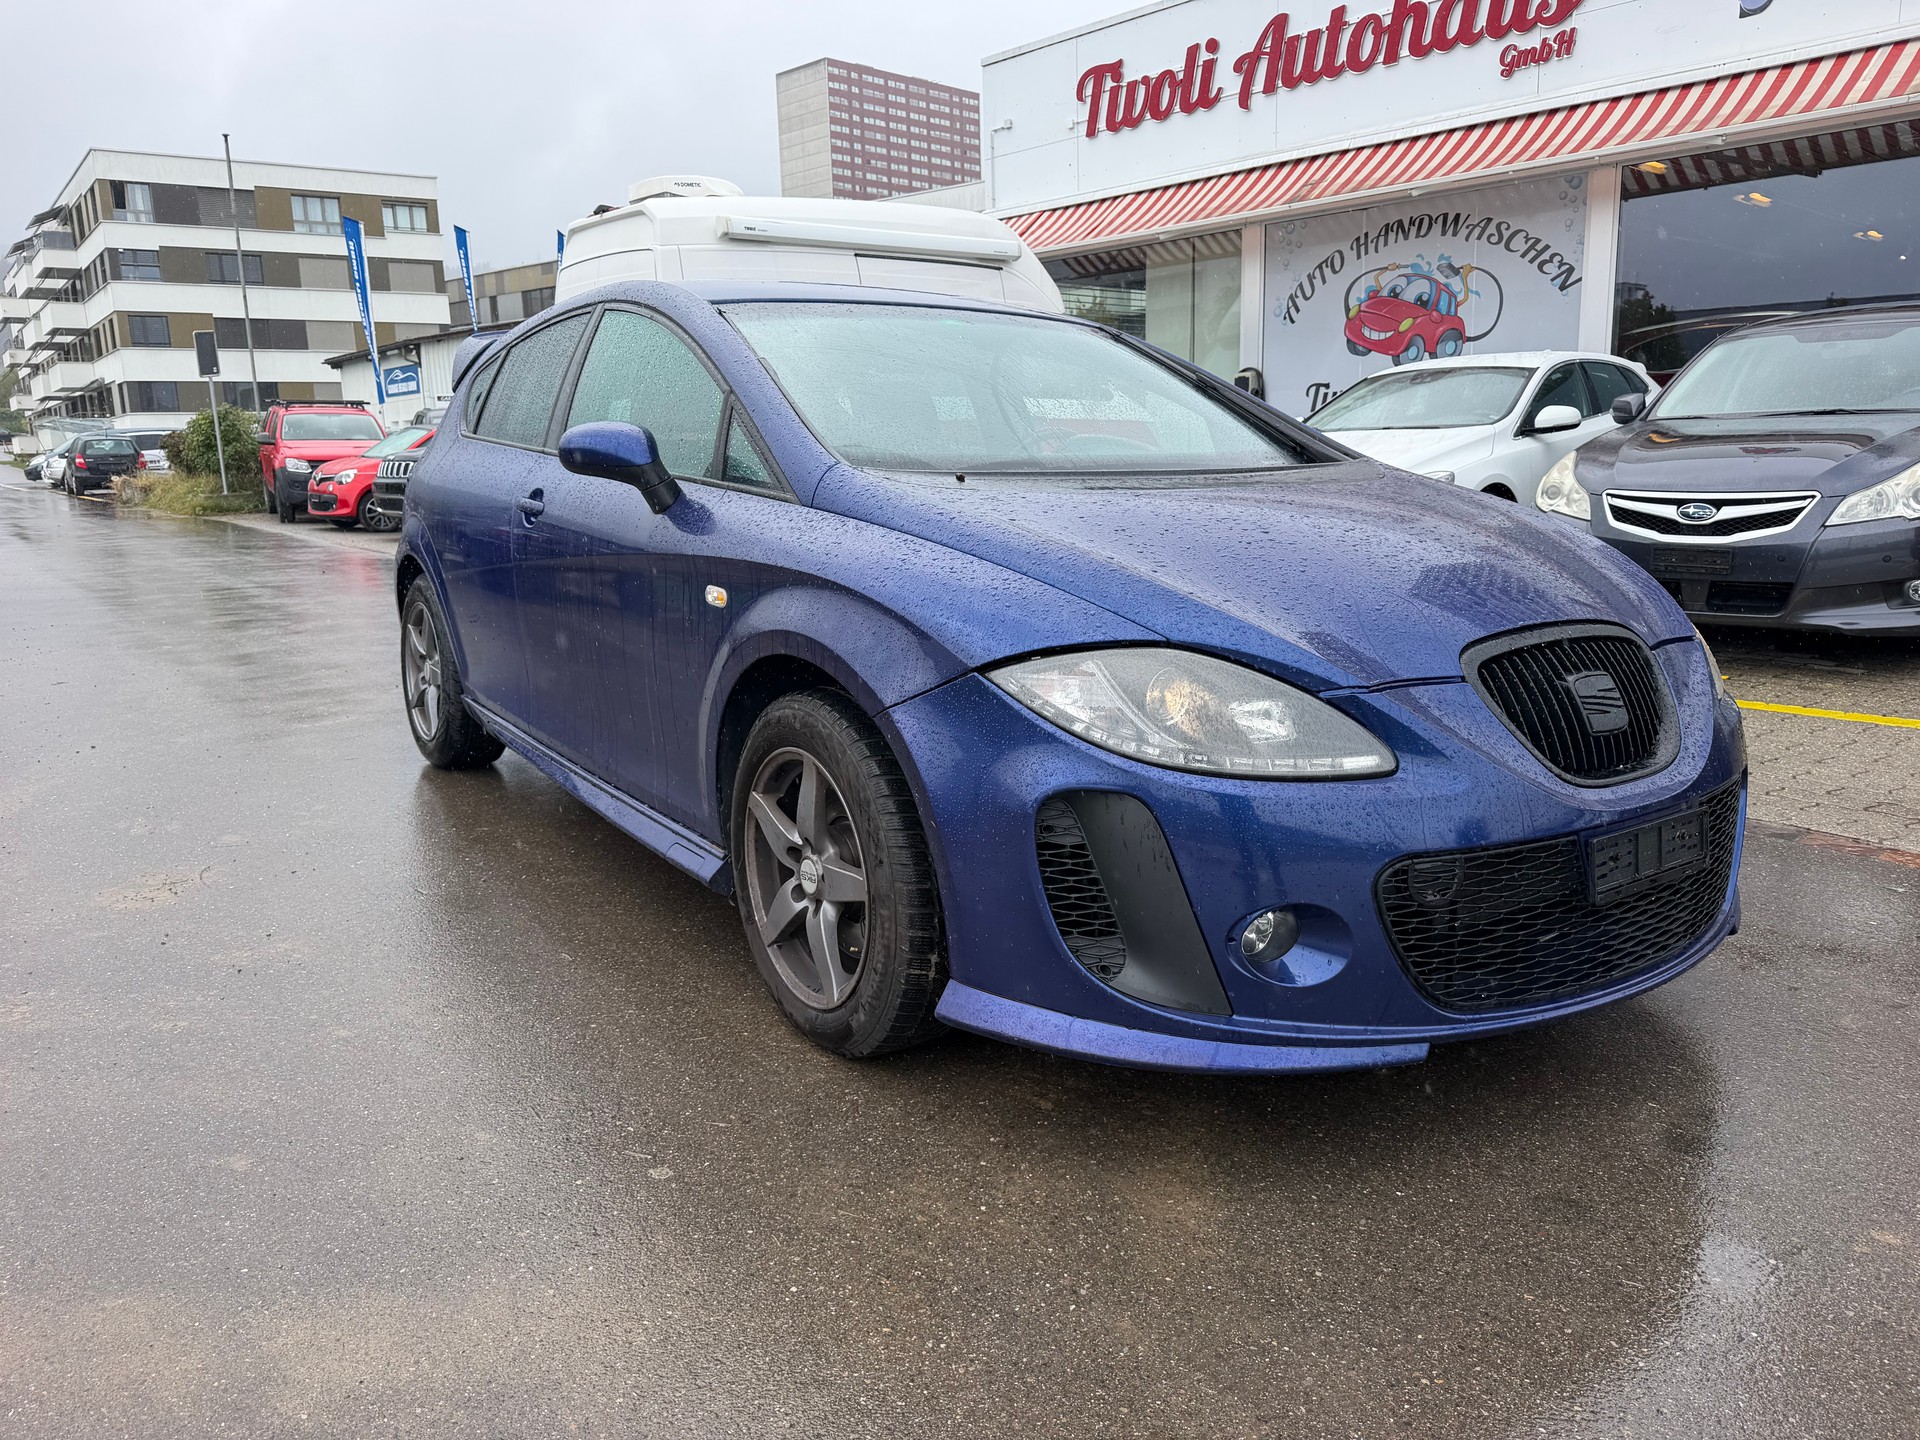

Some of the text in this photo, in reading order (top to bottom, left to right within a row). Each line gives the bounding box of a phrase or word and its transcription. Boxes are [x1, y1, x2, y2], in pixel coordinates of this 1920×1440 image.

[1076, 37, 1223, 139] Tivoli
[1500, 27, 1578, 79] GmbH
[1283, 212, 1583, 325] AUTO HANDWASCHEN
